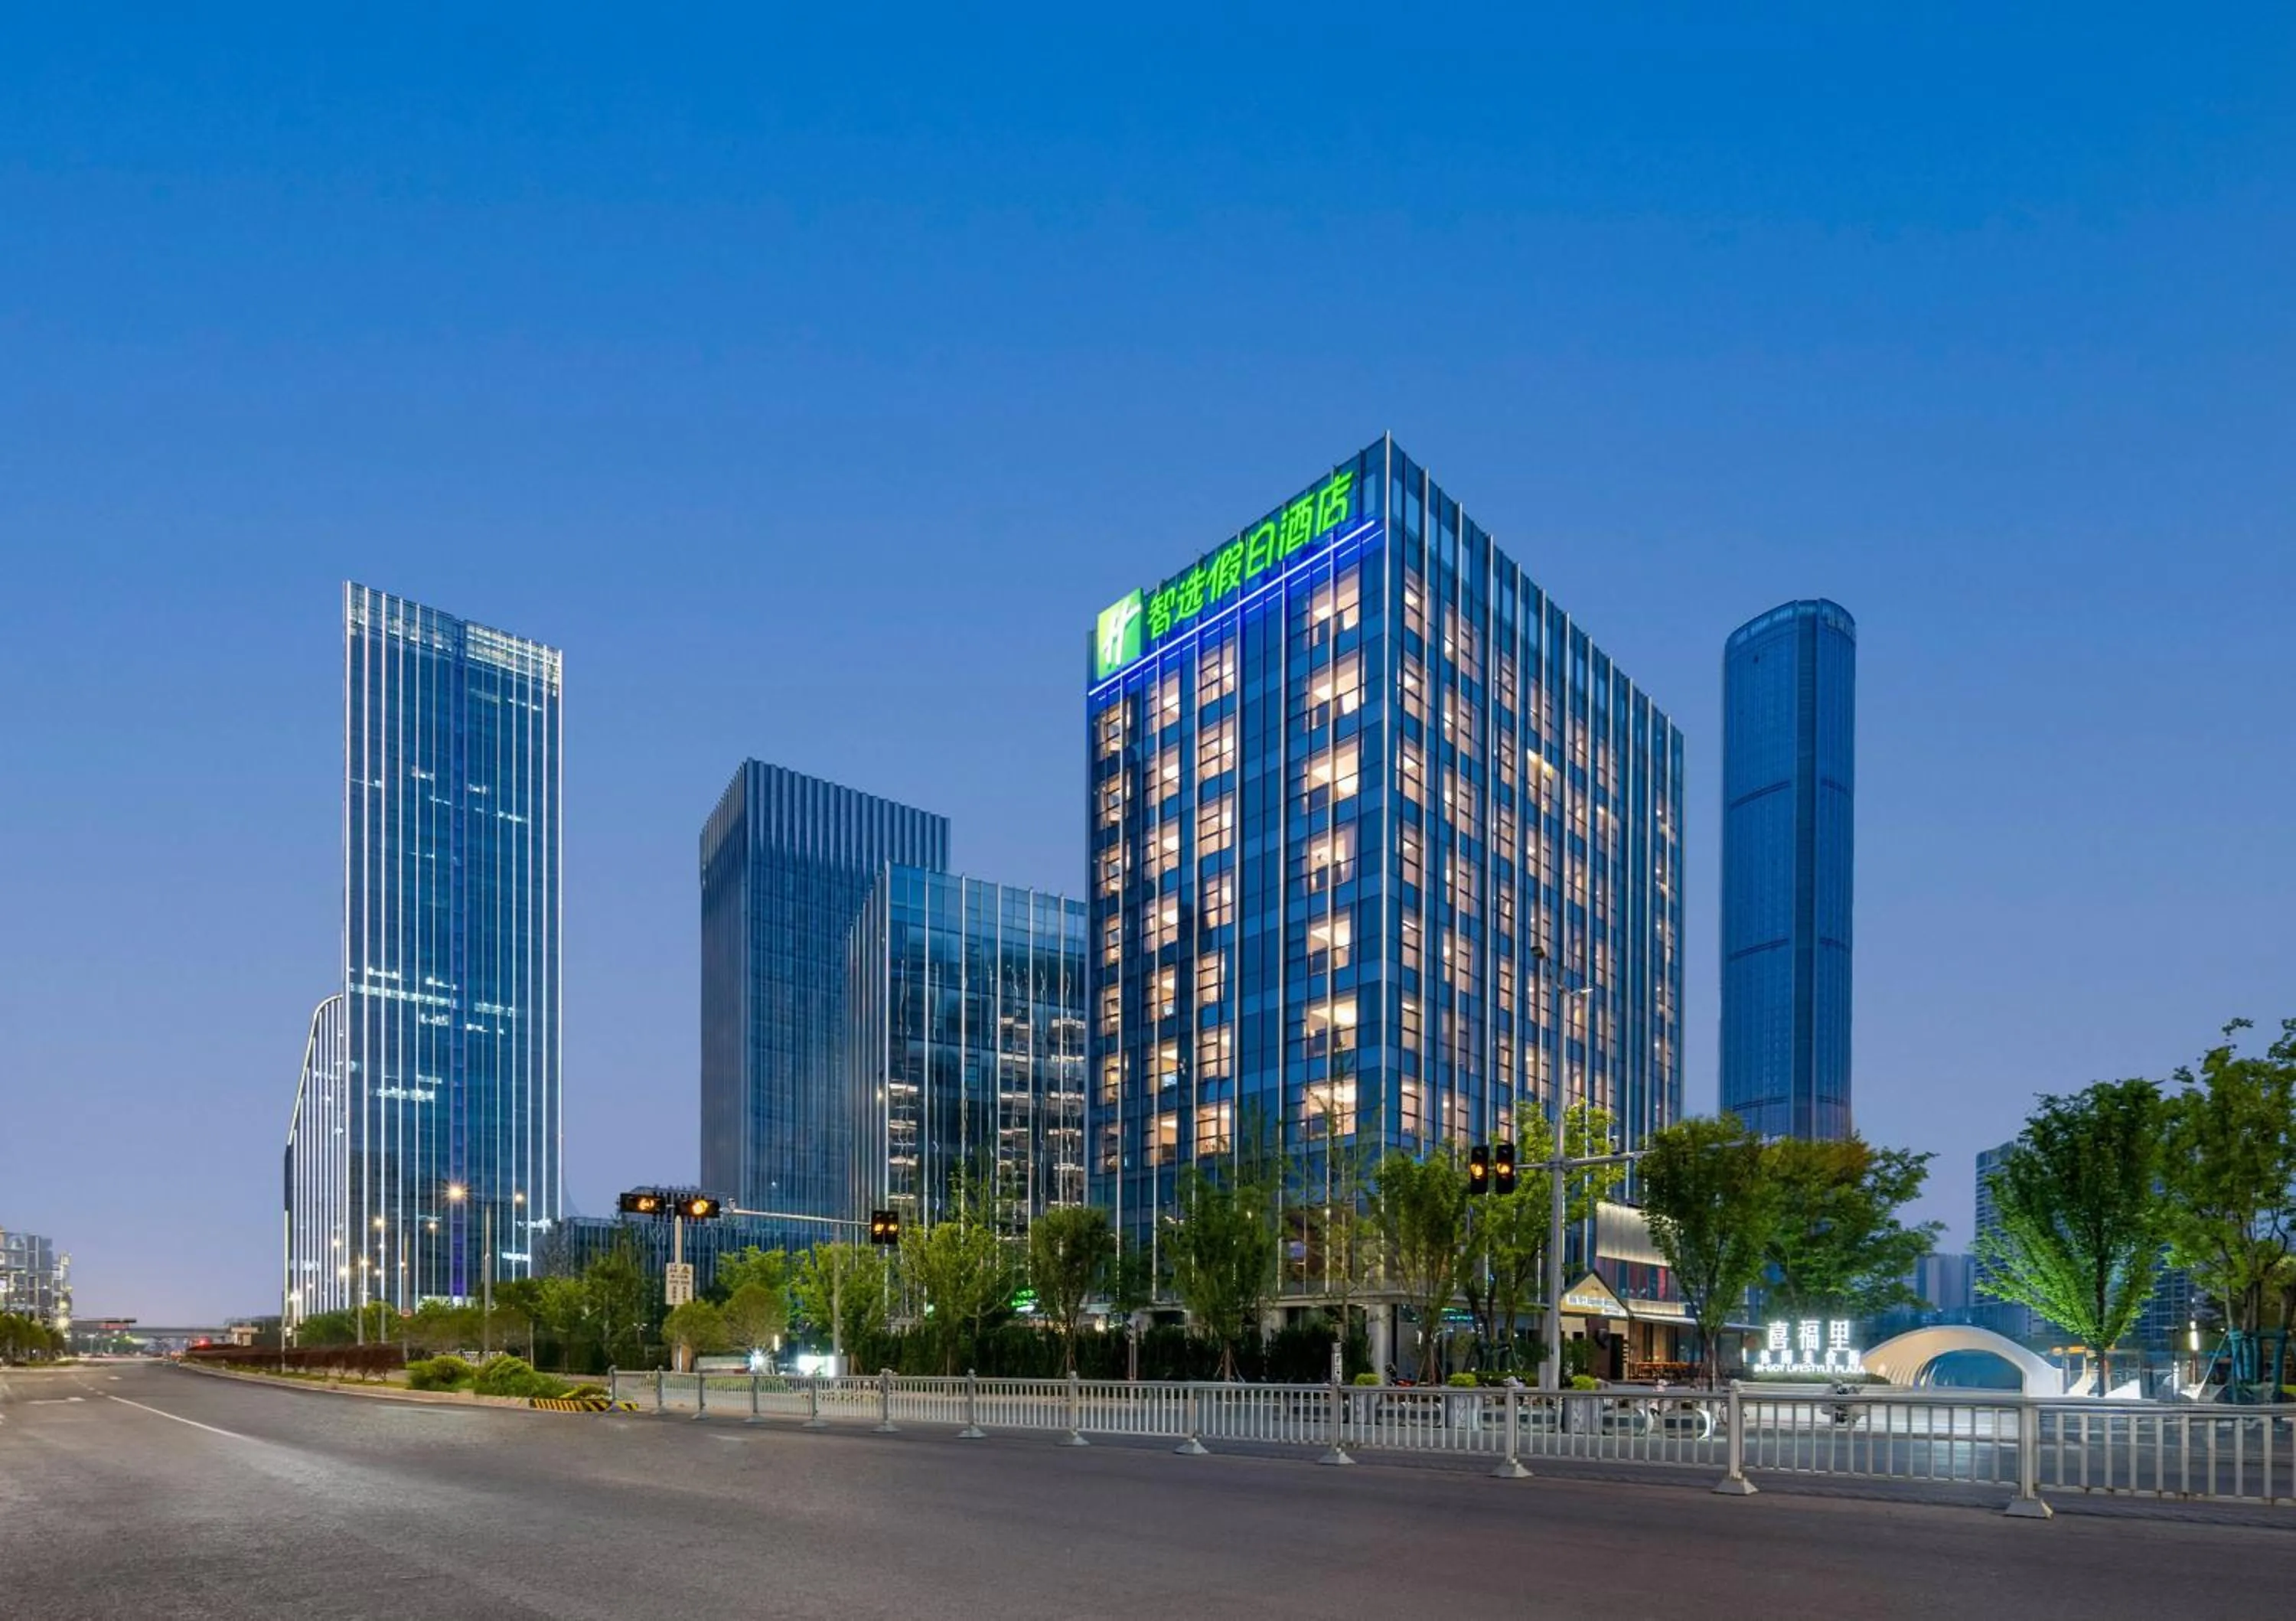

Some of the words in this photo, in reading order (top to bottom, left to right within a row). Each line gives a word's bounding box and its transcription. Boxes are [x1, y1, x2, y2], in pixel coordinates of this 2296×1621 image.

[1147, 471, 1353, 641] 智选假日酒店
[1767, 1319, 1851, 1351] 喜福里
